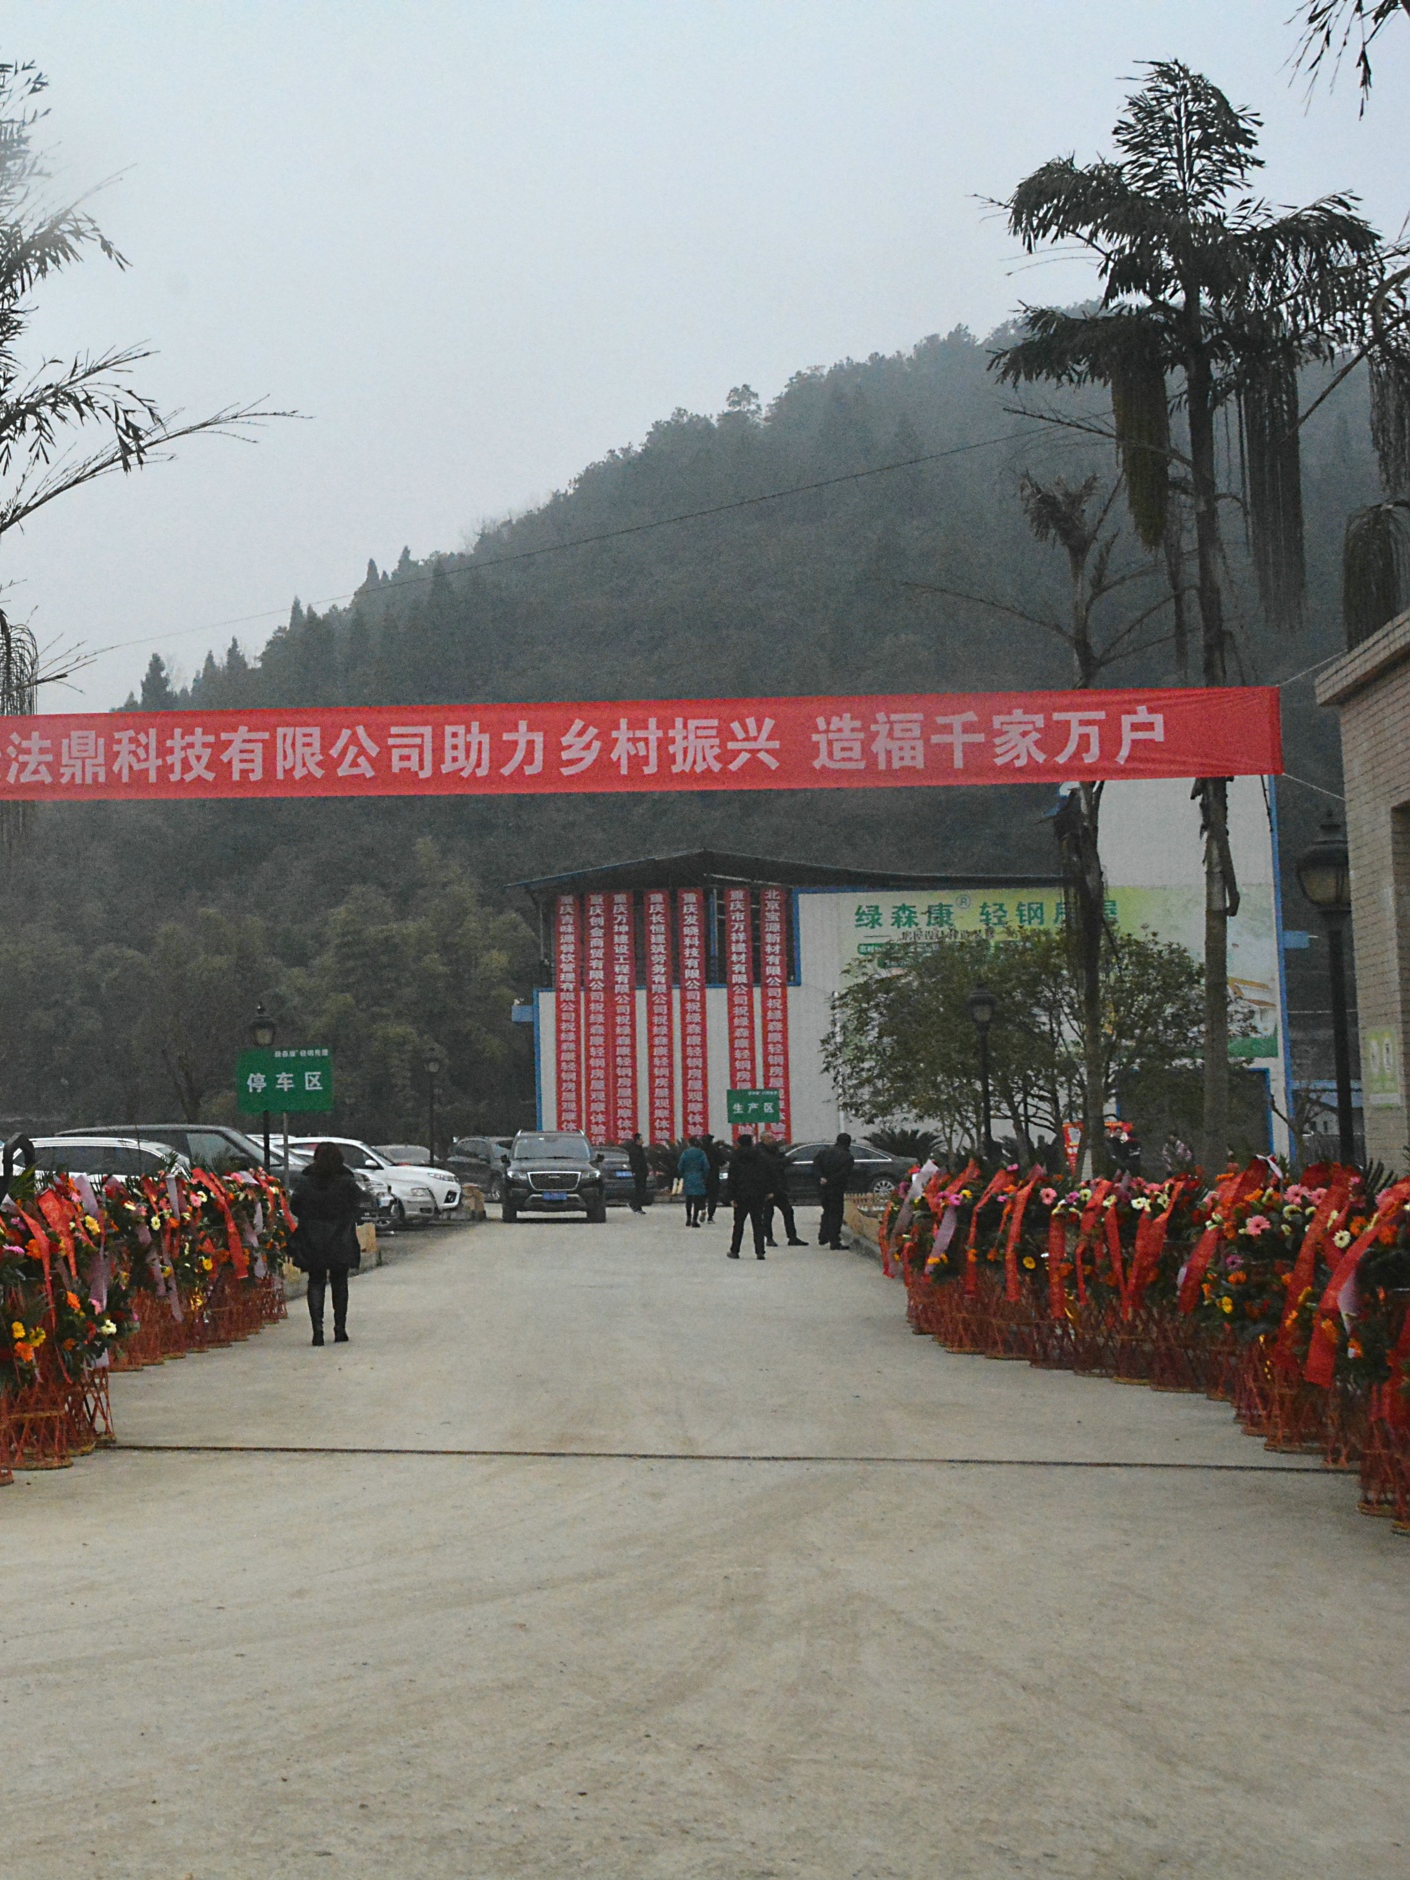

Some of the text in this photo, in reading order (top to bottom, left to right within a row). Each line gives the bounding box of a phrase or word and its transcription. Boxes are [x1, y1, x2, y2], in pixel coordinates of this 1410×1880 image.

[812, 704, 1167, 771] 造福千家万户
[854, 902, 954, 929] 绿森康
[247, 1071, 323, 1093] 停车区
[732, 1102, 774, 1114] 生产区
